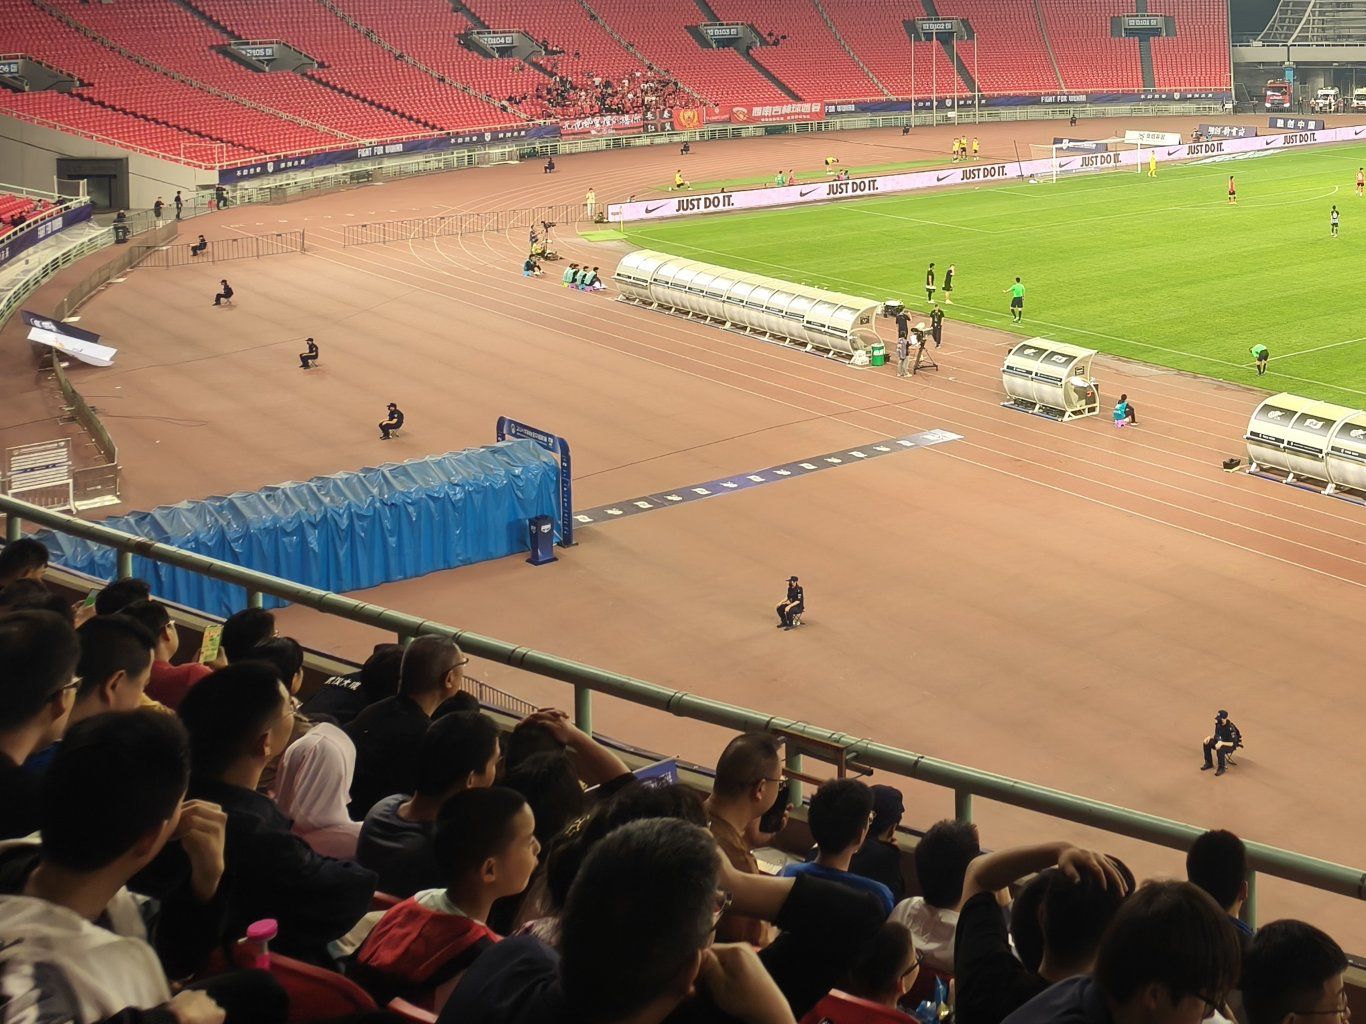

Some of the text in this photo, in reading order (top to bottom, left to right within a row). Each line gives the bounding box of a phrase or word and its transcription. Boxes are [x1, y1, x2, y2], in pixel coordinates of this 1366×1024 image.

[1283, 135, 1298, 145] JUST
[1299, 133, 1309, 143] DO
[1187, 144, 1204, 155] JUST
[1205, 143, 1216, 154] DO
[1080, 155, 1099, 167] JUST
[1100, 154, 1112, 166] DO
[960, 166, 1007, 181] JUST DO IT.
[826, 179, 878, 196] JUST DO IT.
[675, 195, 734, 212] JUST DO IT.
